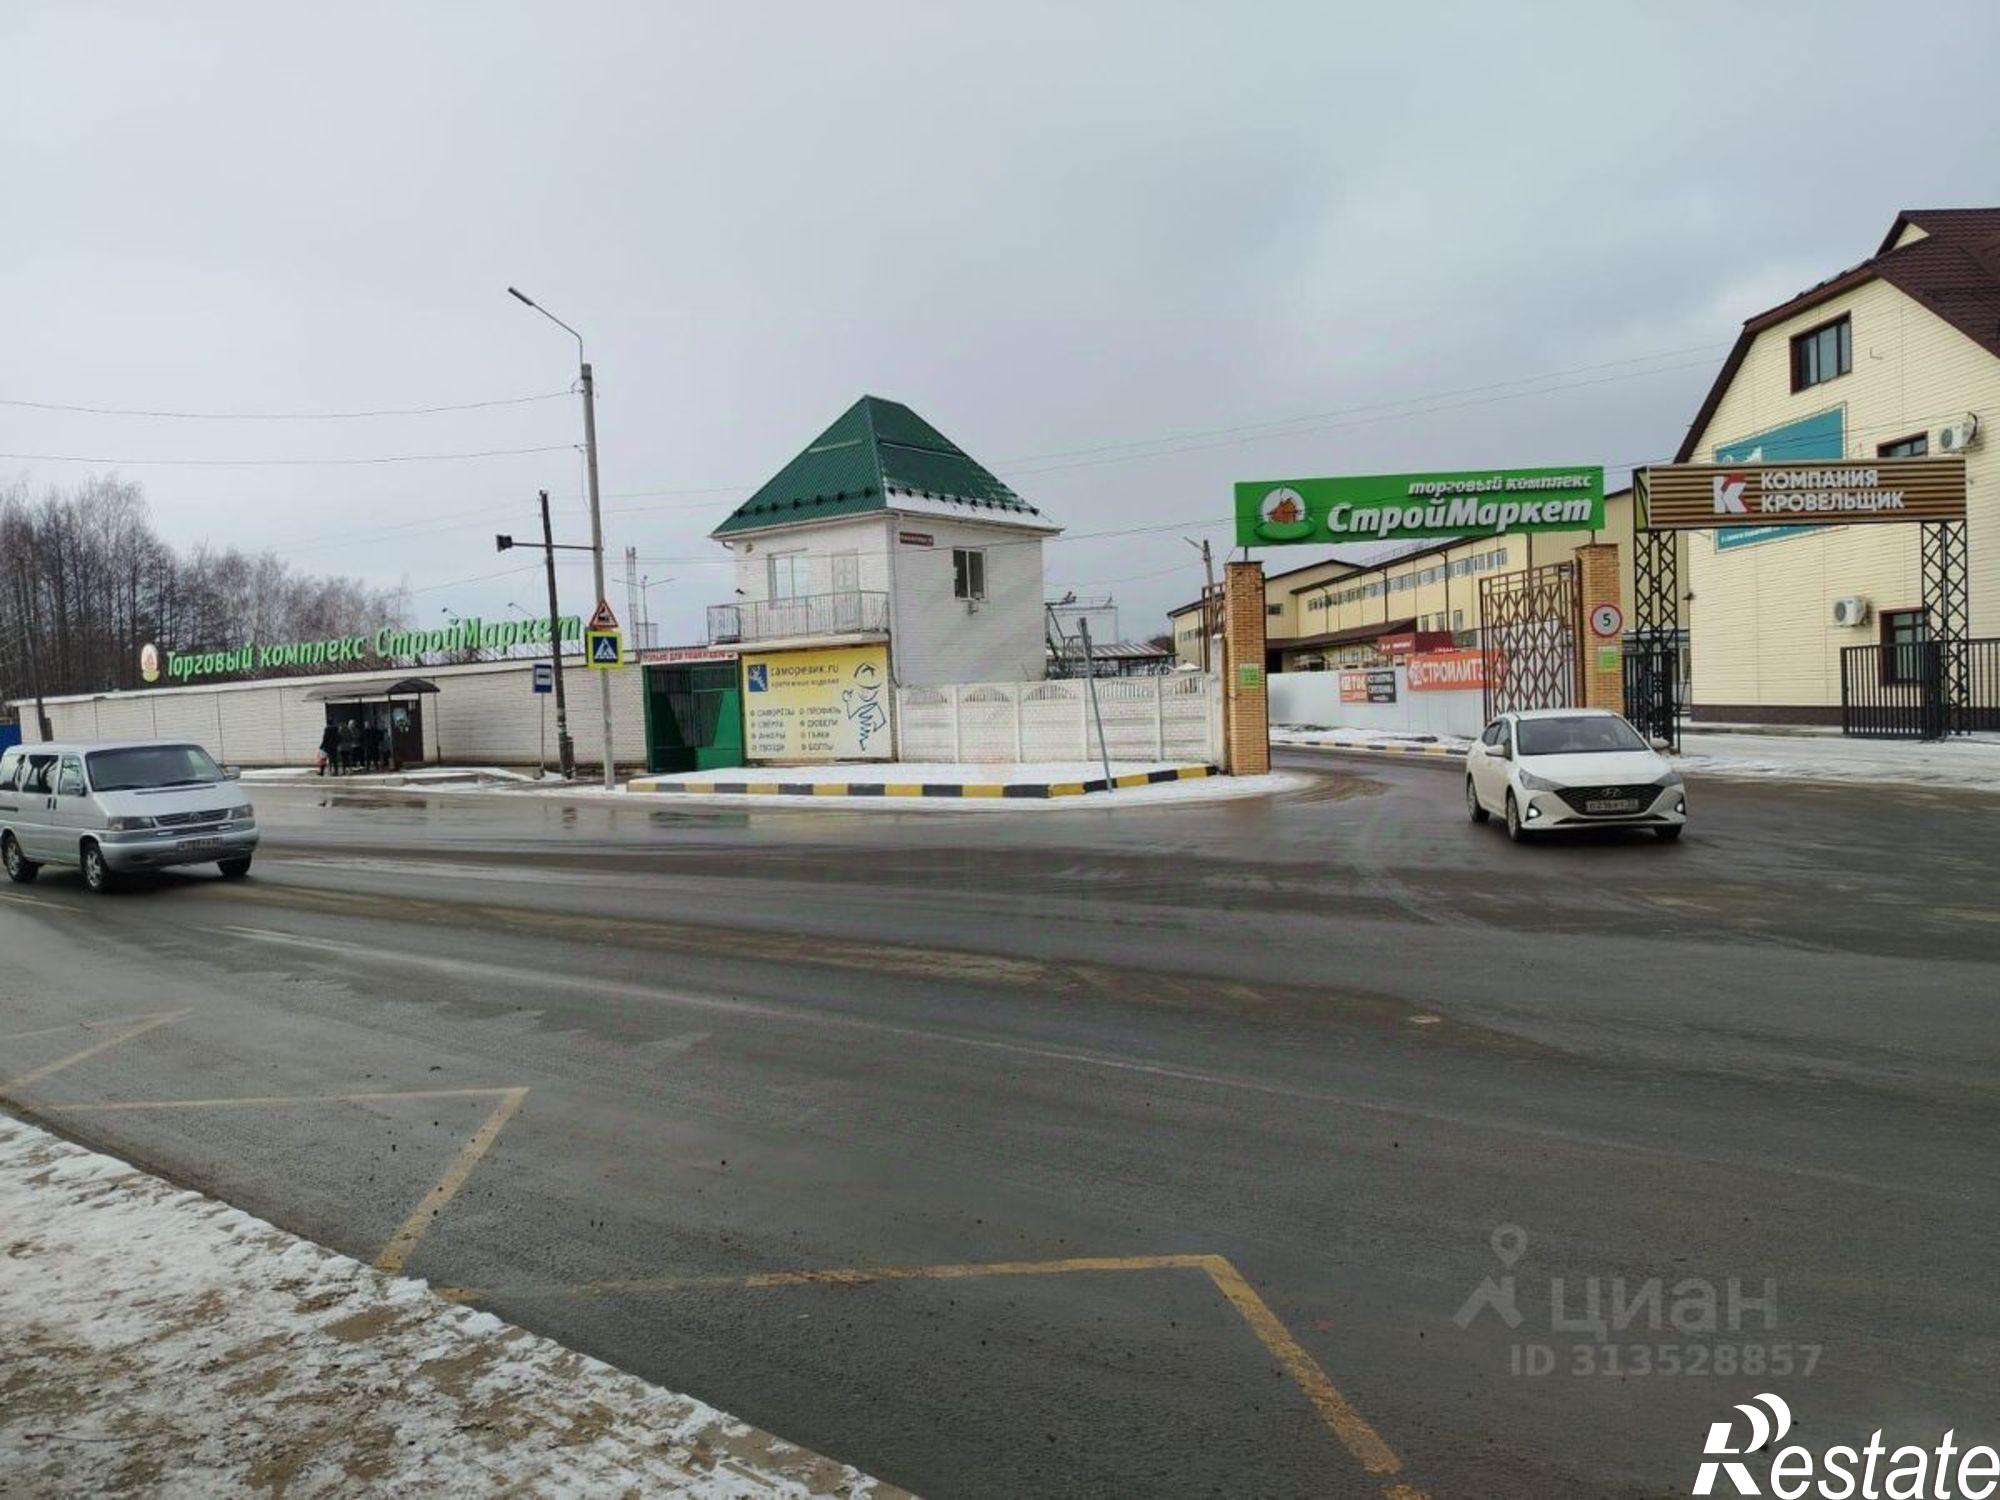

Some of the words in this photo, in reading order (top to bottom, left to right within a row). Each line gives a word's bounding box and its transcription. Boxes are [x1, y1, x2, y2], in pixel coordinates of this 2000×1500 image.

[1408, 475, 1502, 497] торговый
[1505, 474, 1592, 492] комплекс
[1761, 469, 1878, 490] КОМПАНИЯ
[1761, 491, 1904, 513] КРОВЕЛЬЩИК
[1327, 497, 1593, 539] СтройМаркет
[1602, 612, 1611, 627] 5
[167, 642, 256, 682] Торговый
[260, 636, 366, 667] комплекс
[375, 616, 580, 665] СтройМаркет
